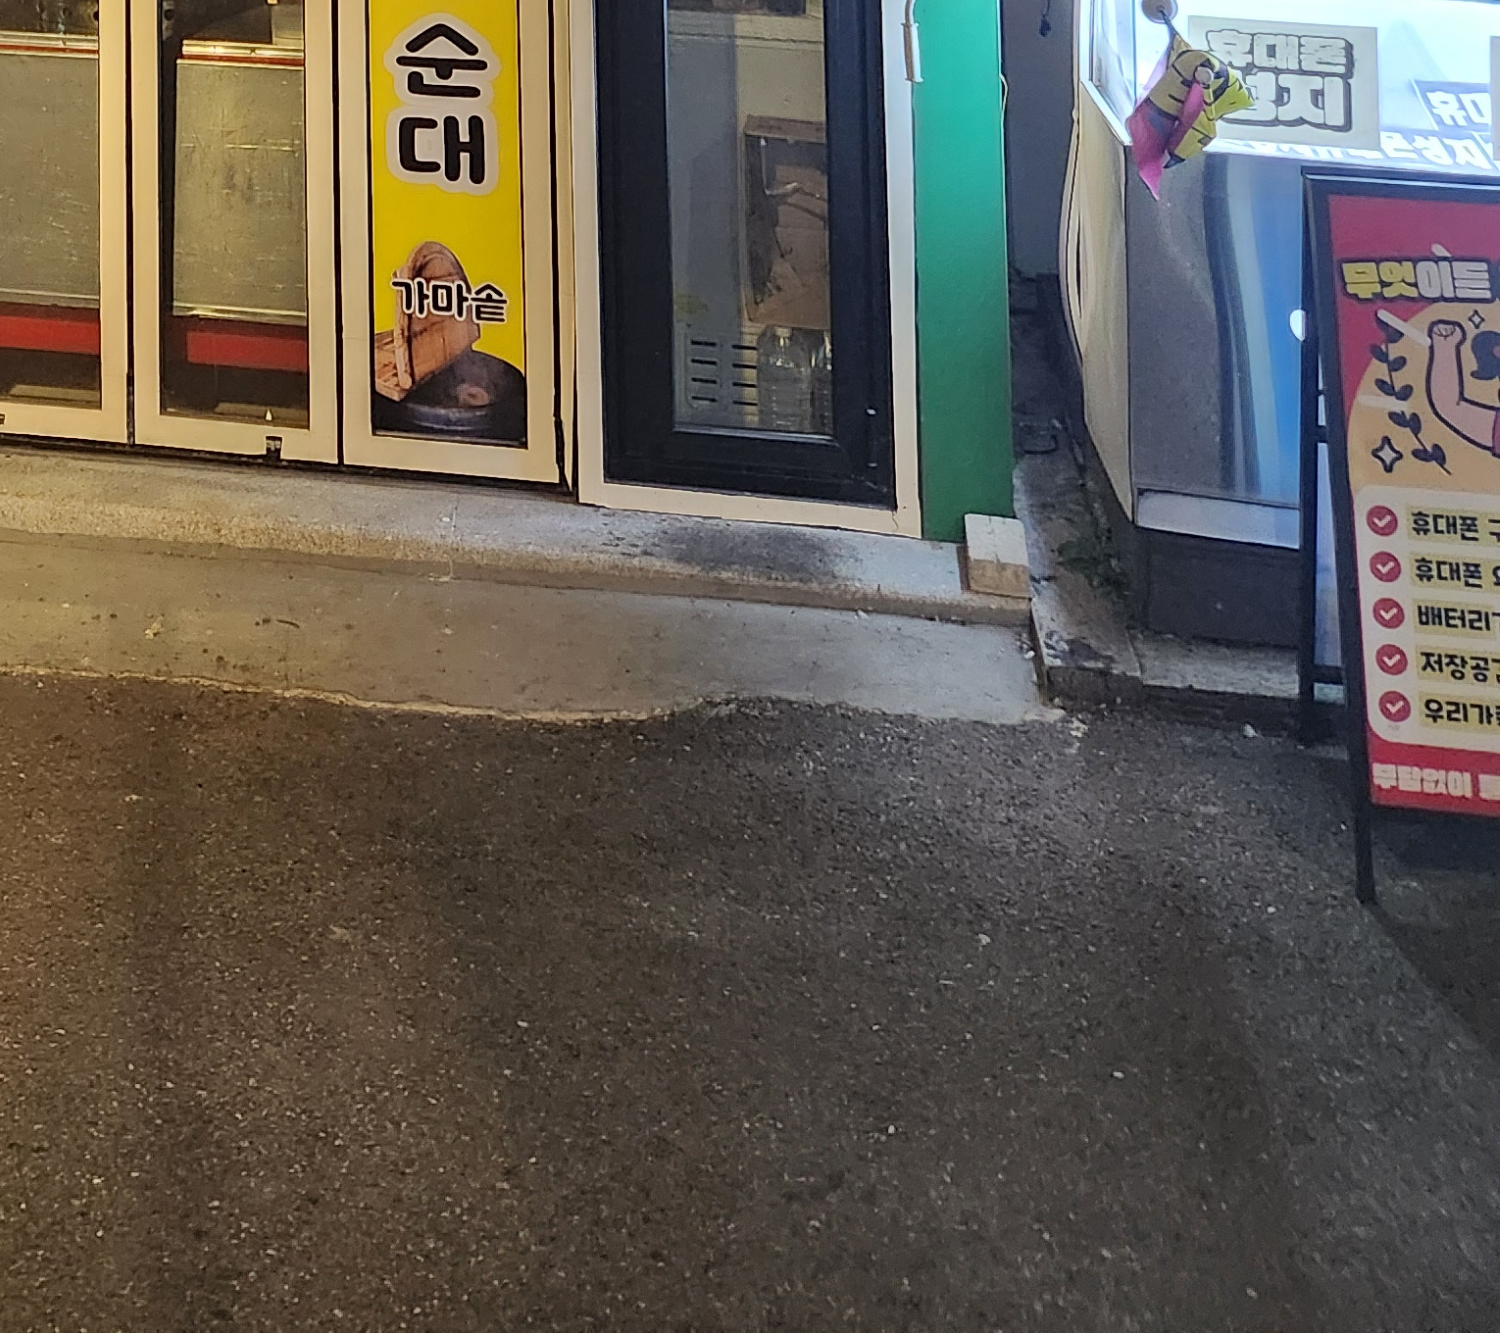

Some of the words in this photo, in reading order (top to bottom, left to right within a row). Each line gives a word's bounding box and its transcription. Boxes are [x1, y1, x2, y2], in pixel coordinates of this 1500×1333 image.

[1206, 29, 1353, 74] 휴대폰
[395, 22, 488, 185] 순대
[1341, 259, 1493, 300] 무엇이든
[392, 280, 508, 323] 가마솥
[1411, 510, 1480, 542] 휴대폰
[1415, 557, 1483, 589] 휴대폰
[1417, 604, 1500, 633] 배터리
